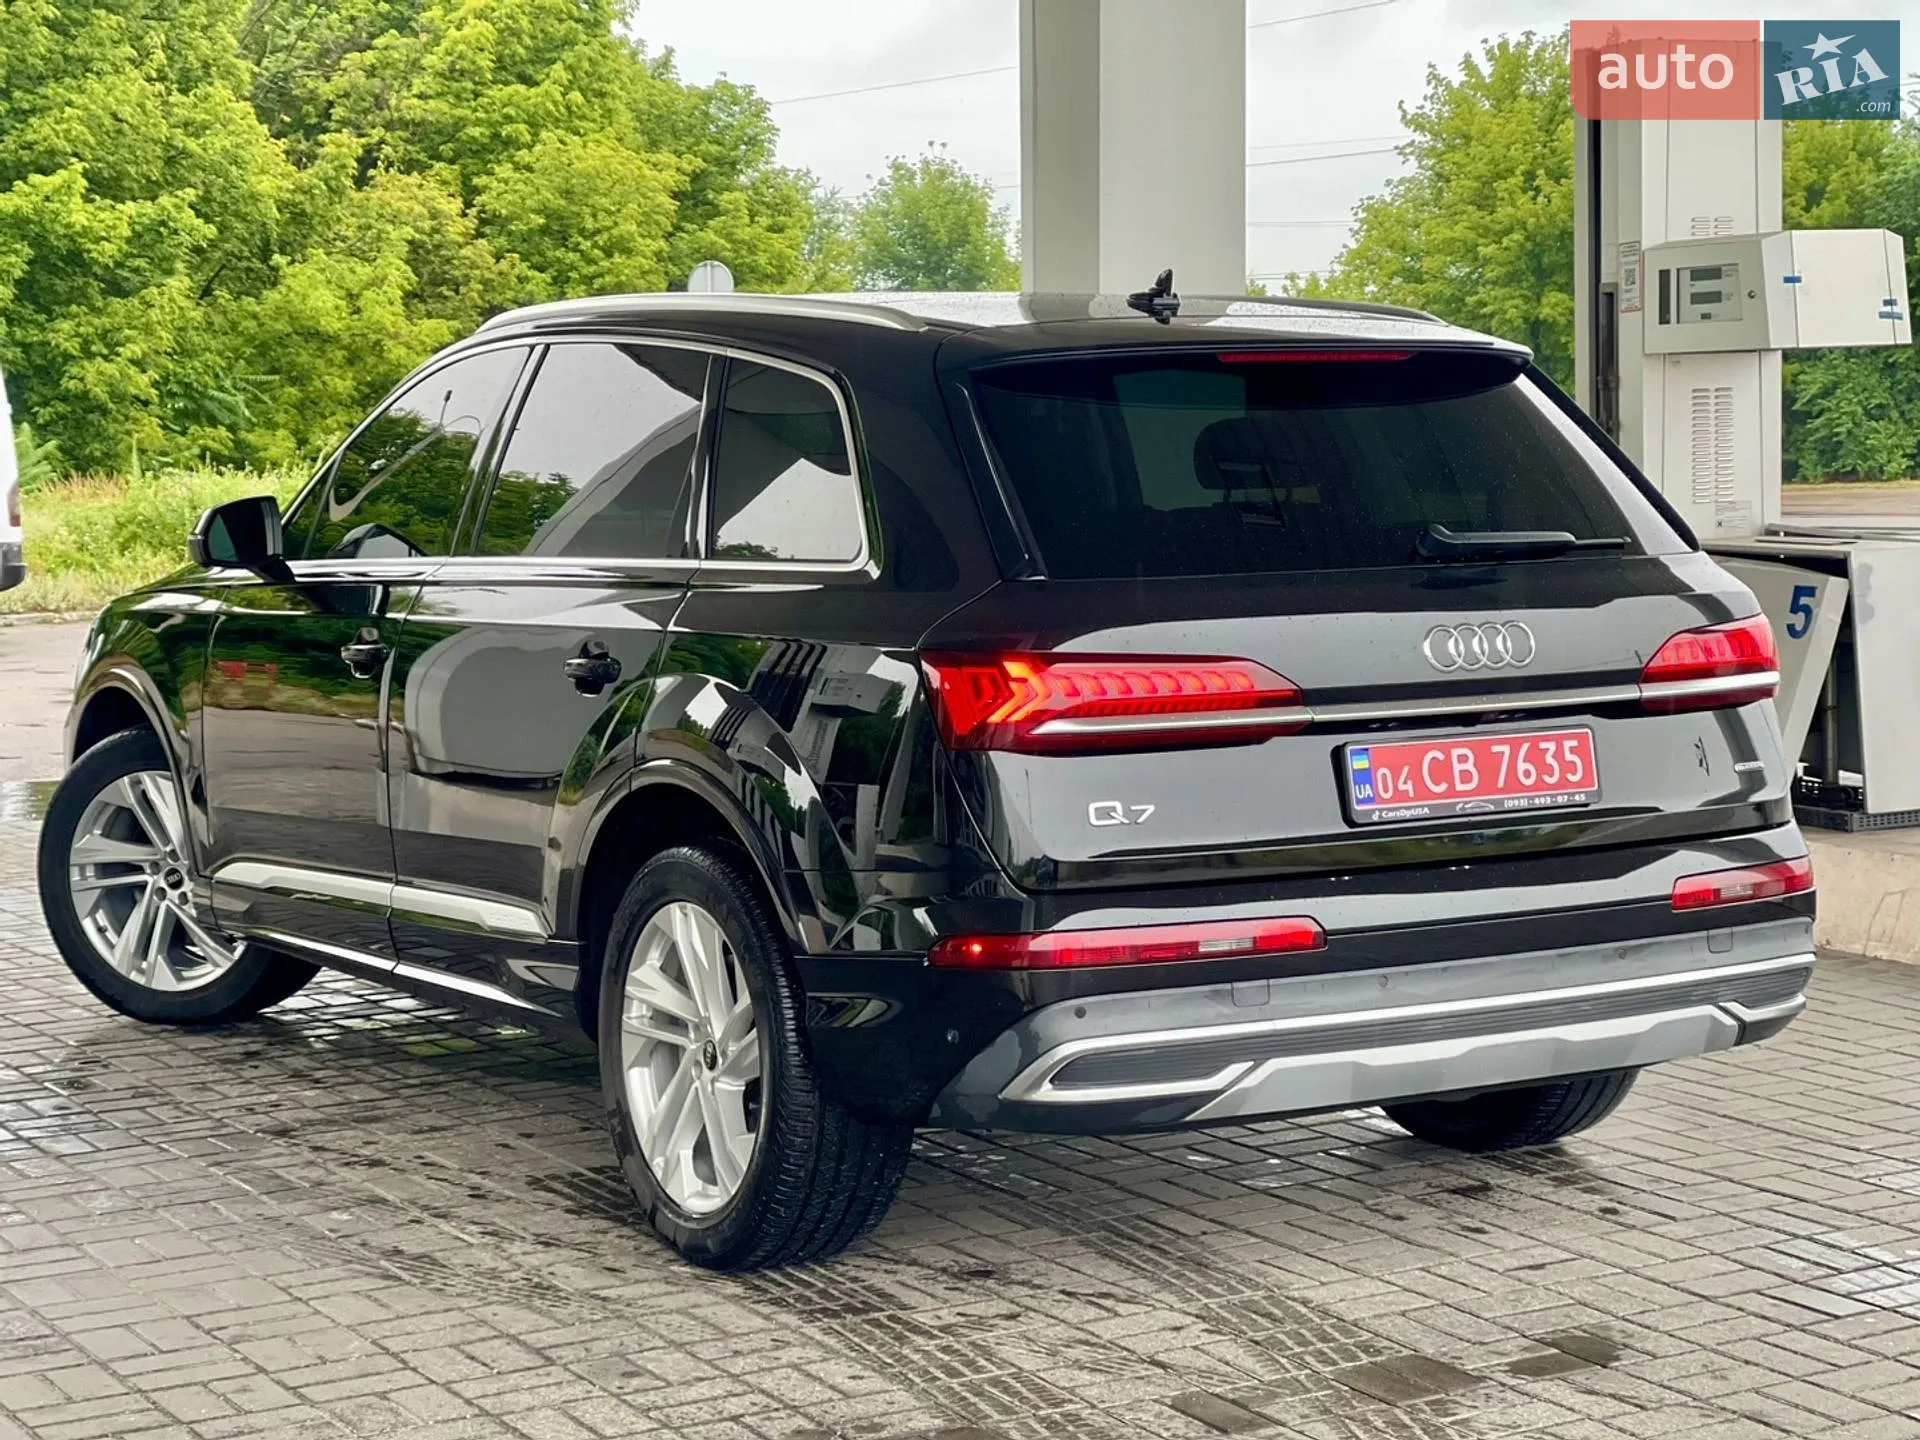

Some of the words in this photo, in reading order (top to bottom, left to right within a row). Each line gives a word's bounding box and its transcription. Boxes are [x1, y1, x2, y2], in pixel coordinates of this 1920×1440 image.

[1786, 585, 1818, 639] 5
[1376, 765, 1415, 799] 04
[1422, 747, 1479, 793] CB
[1490, 739, 1584, 788] 7635
[1355, 783, 1374, 799] UA
[1088, 801, 1155, 825] Q7
